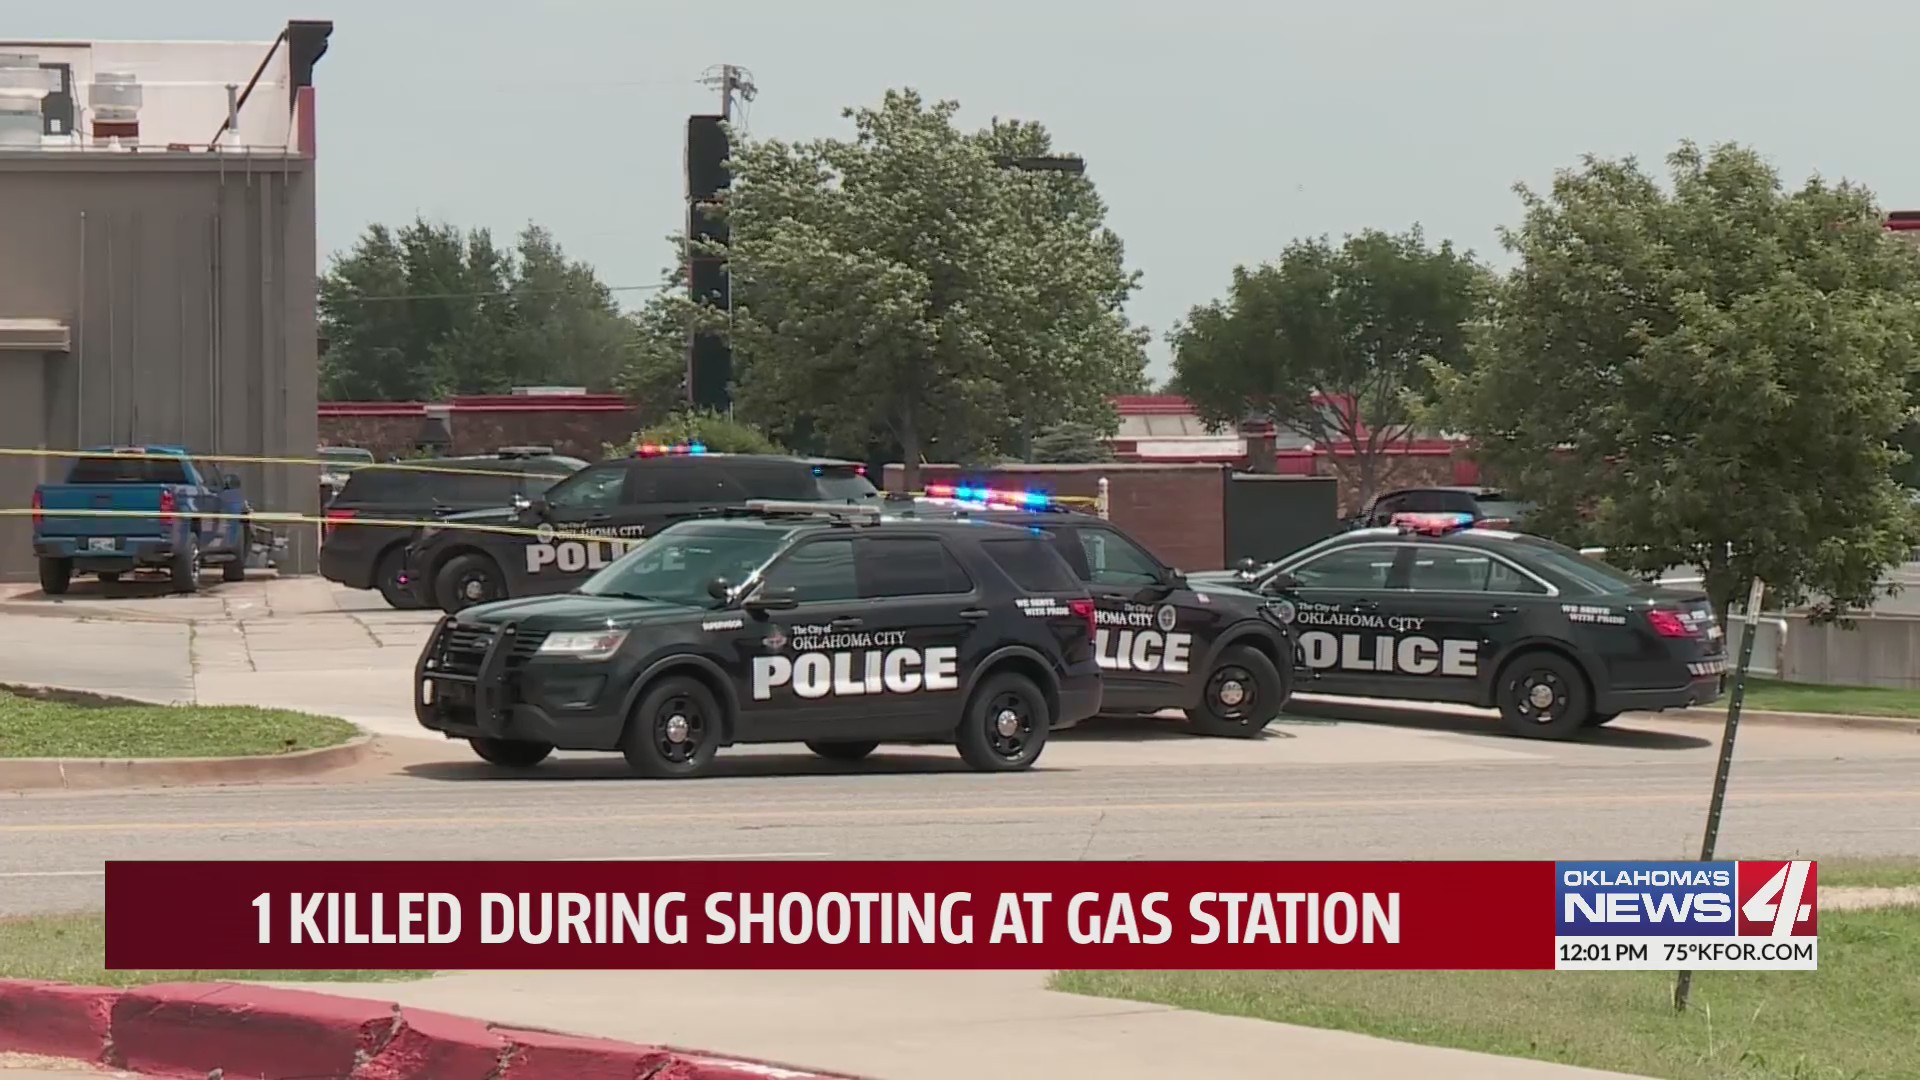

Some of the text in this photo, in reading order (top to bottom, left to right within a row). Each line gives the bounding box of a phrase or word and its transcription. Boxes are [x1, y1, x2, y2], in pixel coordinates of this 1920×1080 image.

[1299, 602, 1341, 613] The City of
[1095, 611, 1154, 627] HOMA CITY
[1297, 612, 1425, 630] OKLAHOMA CITY
[792, 624, 832, 635] The City of
[792, 630, 906, 651] OKLAHOMA CITY
[1095, 629, 1192, 672] LICE
[1299, 631, 1479, 677] OLICE
[752, 646, 959, 700] POLICE
